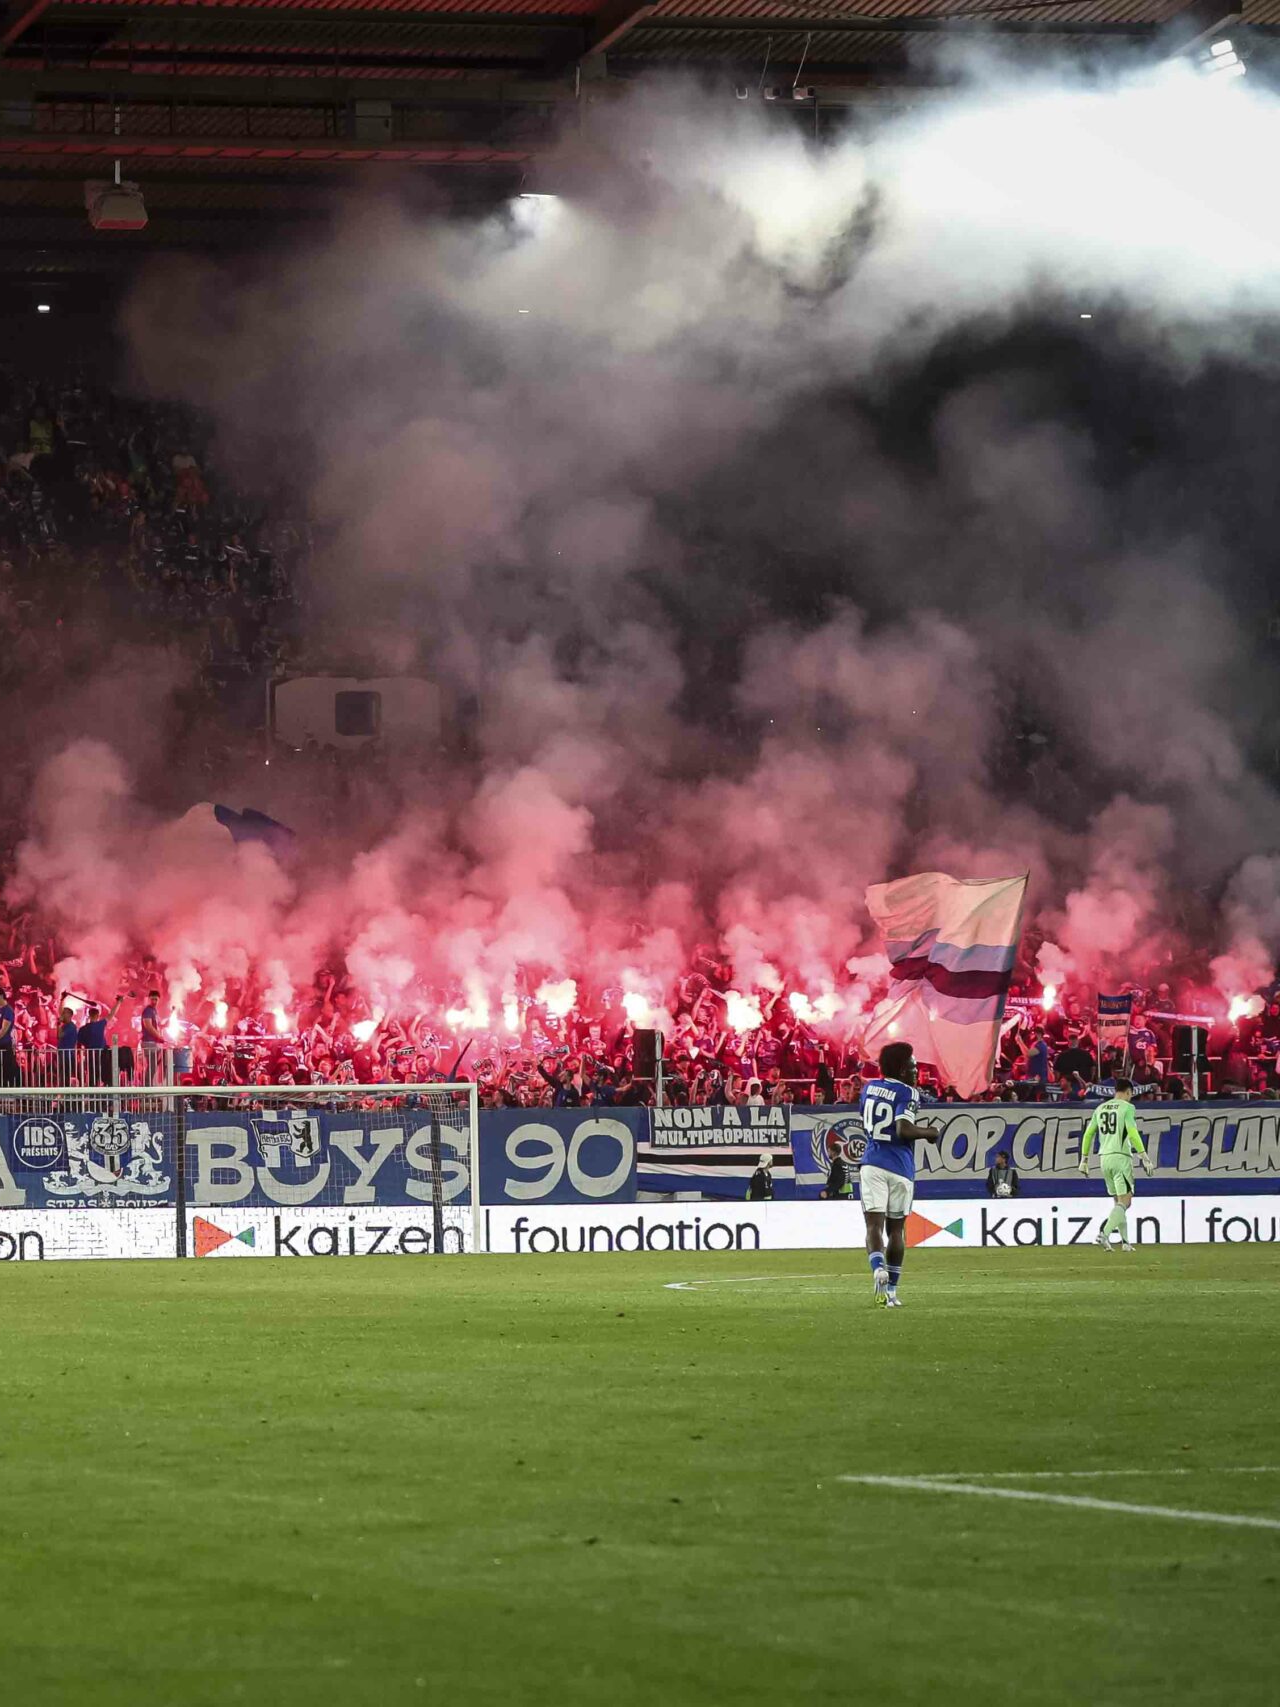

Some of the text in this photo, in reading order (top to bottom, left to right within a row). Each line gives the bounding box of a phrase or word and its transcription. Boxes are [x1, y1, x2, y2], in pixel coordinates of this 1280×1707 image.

[653, 1106, 786, 1128] NON A LA
[1100, 1112, 1117, 1135] 39
[23, 1126, 55, 1146] IDS
[93, 1122, 128, 1147] 35
[655, 1128, 787, 1146] MULTIPROPRIETE
[913, 1113, 1006, 1173] KOP
[21, 1146, 58, 1157] PRÉSENTS
[186, 1124, 470, 1204] BOYS
[504, 1118, 634, 1200] 90
[275, 1215, 759, 1256] kaizen foundation
[1205, 1207, 1280, 1242] fou
